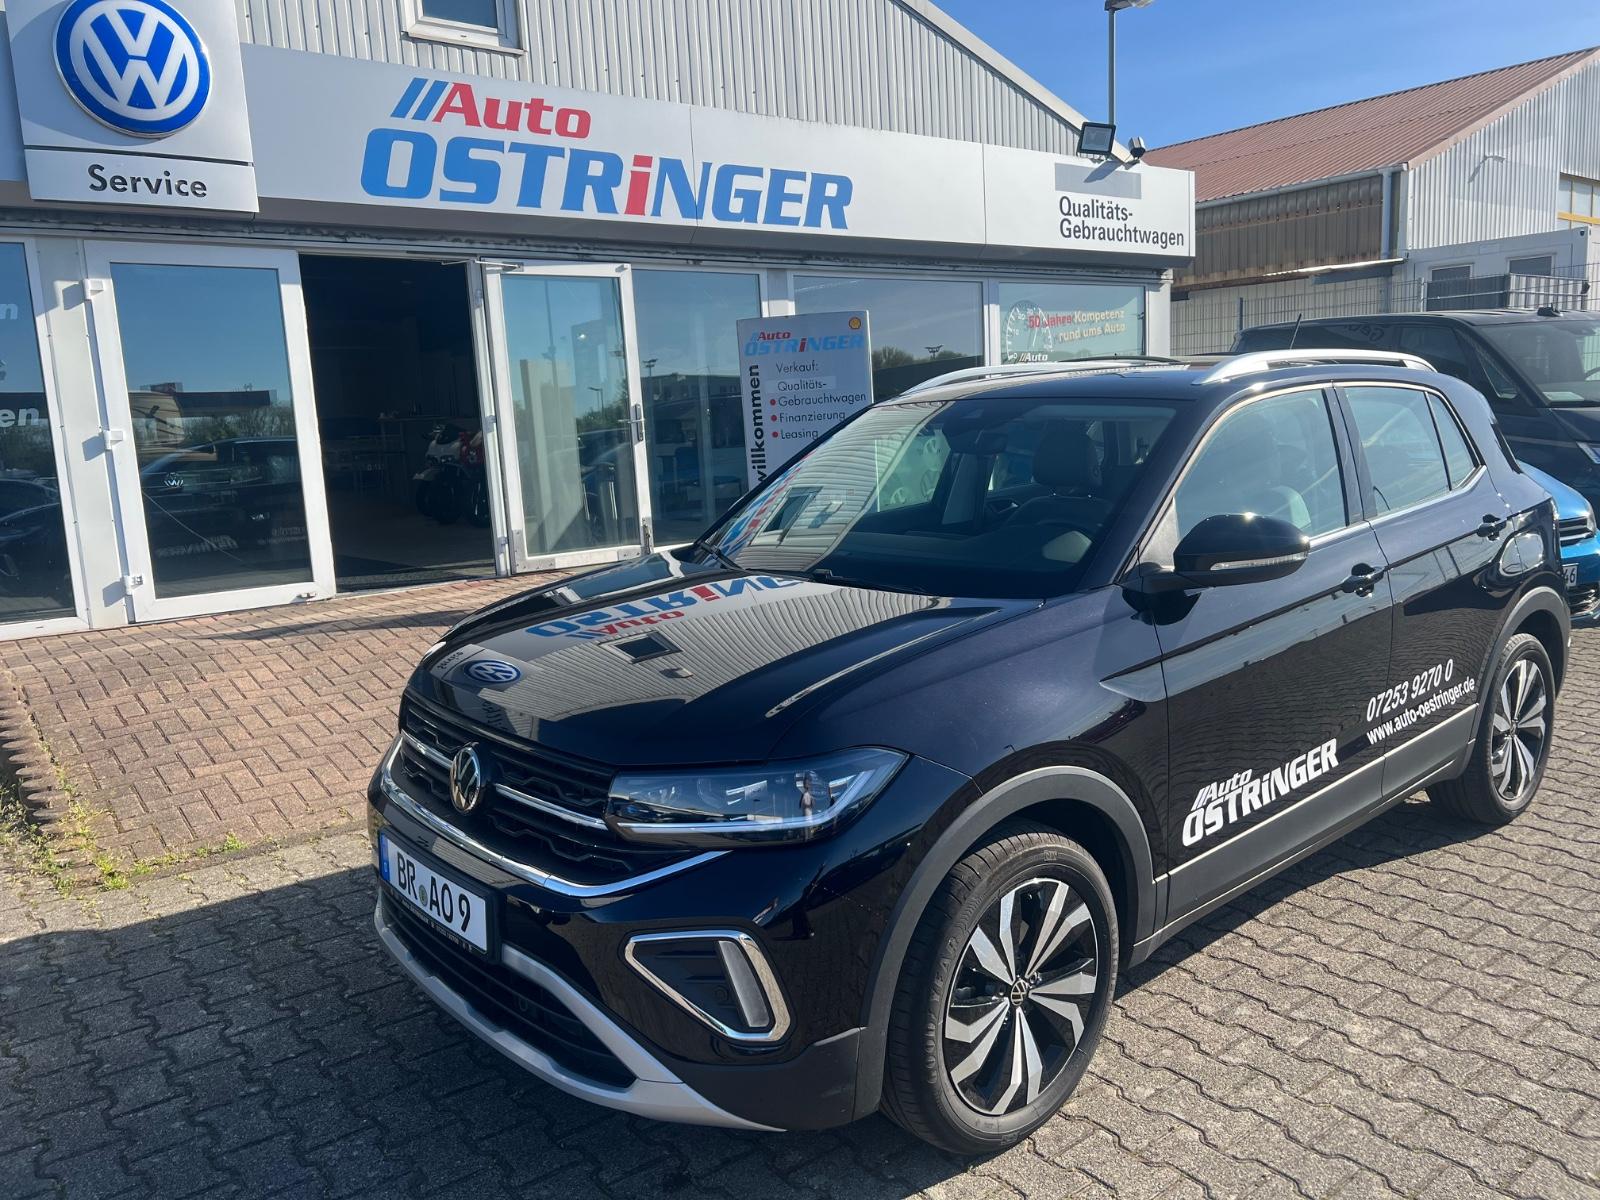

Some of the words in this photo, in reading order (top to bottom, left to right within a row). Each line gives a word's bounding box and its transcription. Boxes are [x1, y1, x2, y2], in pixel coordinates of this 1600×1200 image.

[87, 164, 208, 199] Service
[1059, 195, 1133, 221] Qualitäts-
[1060, 217, 1185, 249] Gebrauchtwagen
[1074, 309, 1125, 324] Kompetenz
[1060, 327, 1081, 342] rund
[1083, 325, 1102, 338] ums
[1103, 322, 1126, 334] Auto
[776, 360, 819, 374] Verkauf:
[777, 380, 827, 392] Qualitäts-
[778, 392, 867, 408] Gebrauchtwagen
[779, 410, 846, 424] Finanzierung
[781, 429, 819, 440] Leasing
[1366, 683, 1409, 722] 07253
[1411, 668, 1442, 700] 9270
[1445, 658, 1454, 682] 0
[1366, 676, 1475, 745] www.auto-oestringer.de
[1205, 768, 1253, 801] Auto
[397, 852, 418, 900] BR
